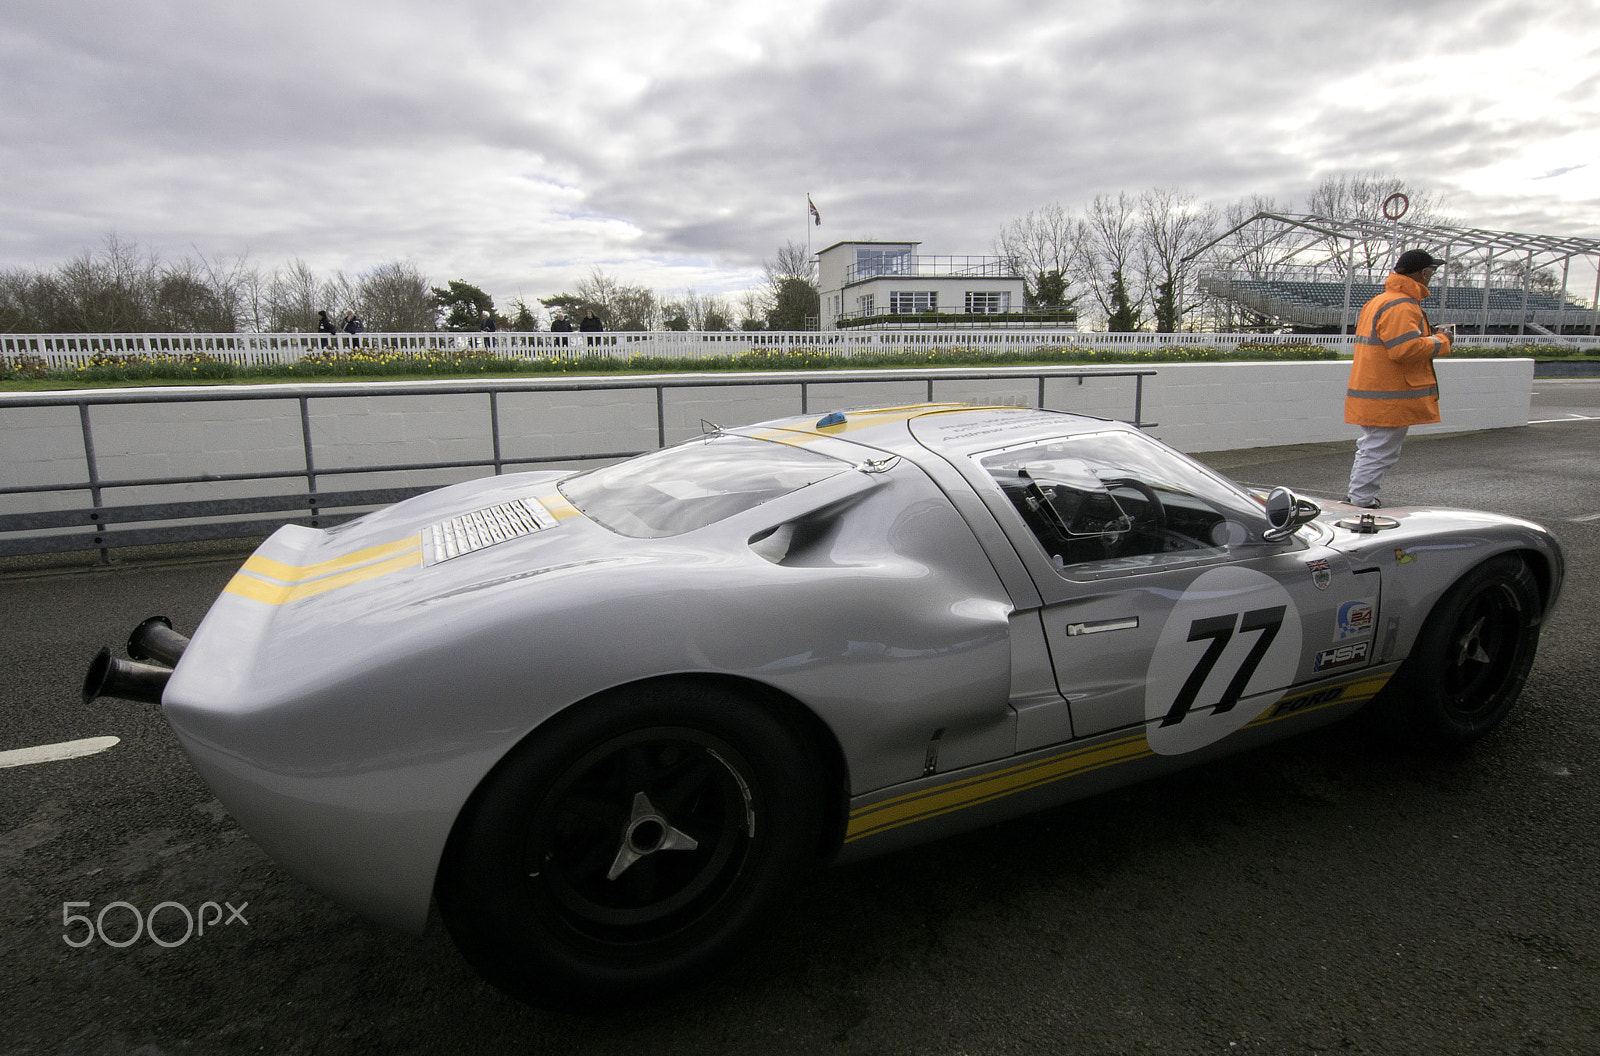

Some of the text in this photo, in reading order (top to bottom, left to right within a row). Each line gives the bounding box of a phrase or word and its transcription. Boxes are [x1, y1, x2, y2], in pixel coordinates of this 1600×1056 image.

[1351, 610, 1372, 623] 24
[1158, 605, 1288, 728] 77
[1320, 642, 1368, 666] HSR
[1271, 687, 1343, 717] FORD
